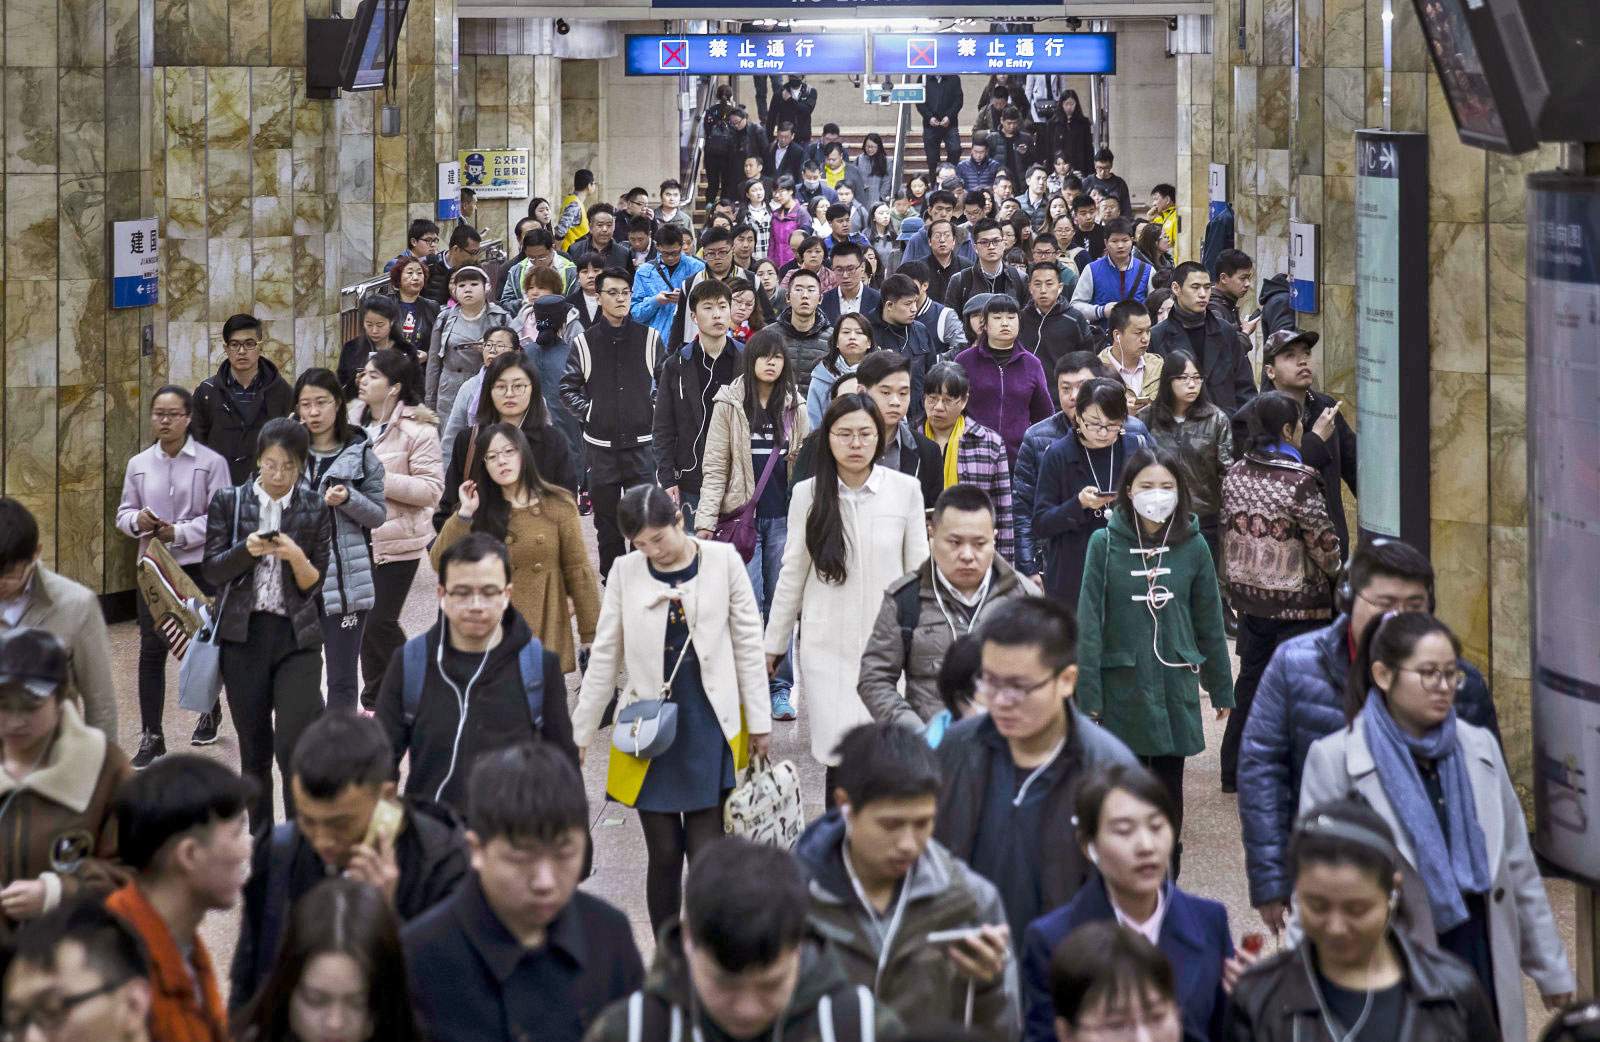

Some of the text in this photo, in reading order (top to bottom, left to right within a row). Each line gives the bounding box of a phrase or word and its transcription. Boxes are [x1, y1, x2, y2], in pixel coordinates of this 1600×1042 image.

[709, 39, 814, 57] 禁止通行
[958, 38, 1064, 57] 禁止通行
[740, 59, 784, 70] No Entry
[989, 59, 1033, 70] No Entry
[1368, 146, 1376, 169] C
